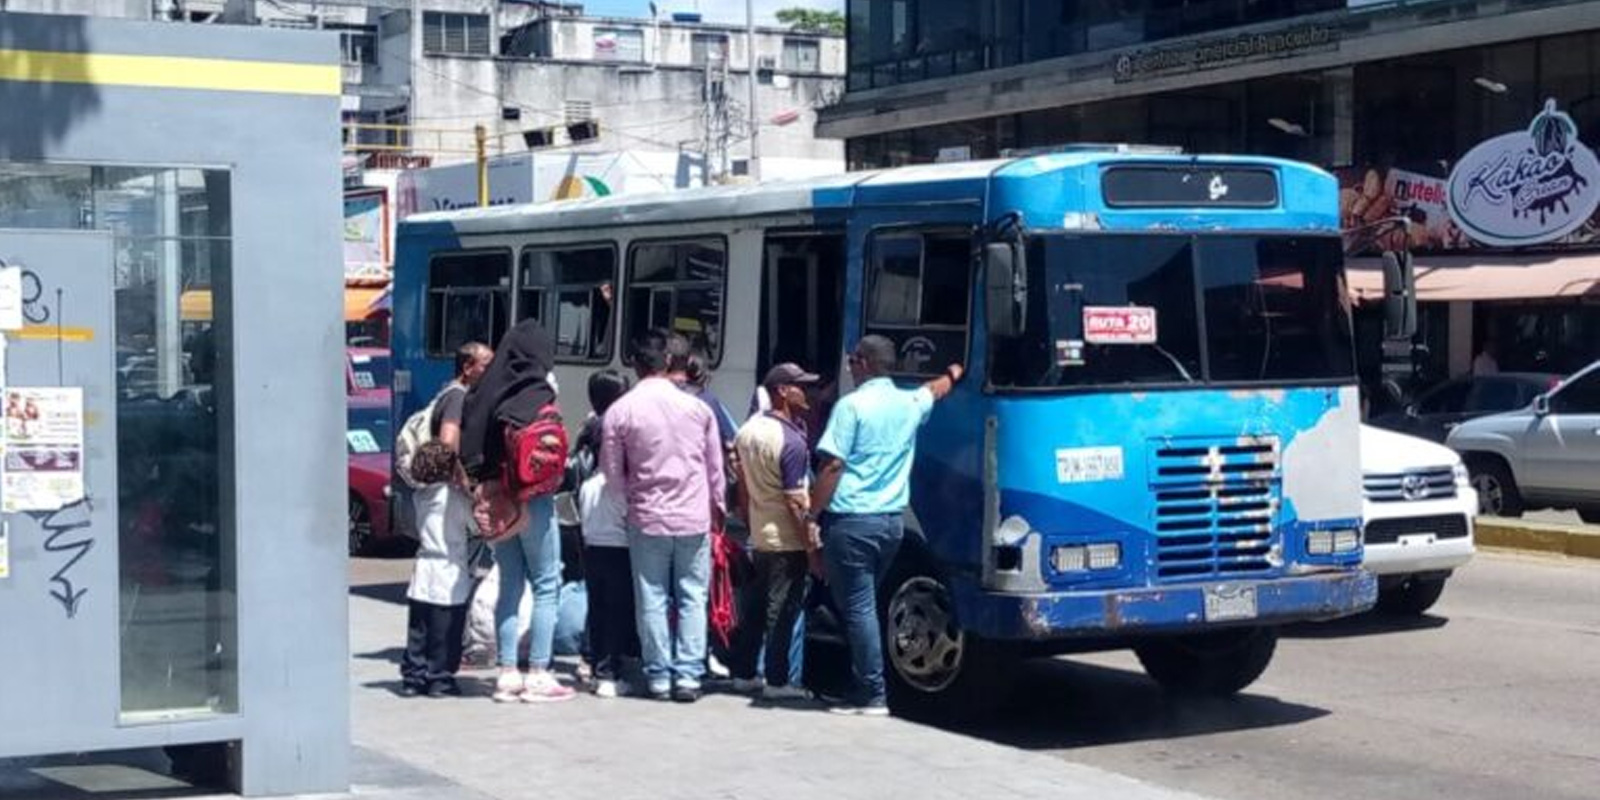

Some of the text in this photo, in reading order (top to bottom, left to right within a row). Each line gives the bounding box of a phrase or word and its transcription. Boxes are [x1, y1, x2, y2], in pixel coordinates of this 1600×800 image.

[1465, 155, 1562, 206] Kakao
[1516, 176, 1571, 207] Cream
[1087, 314, 1151, 330] RUTA 20
